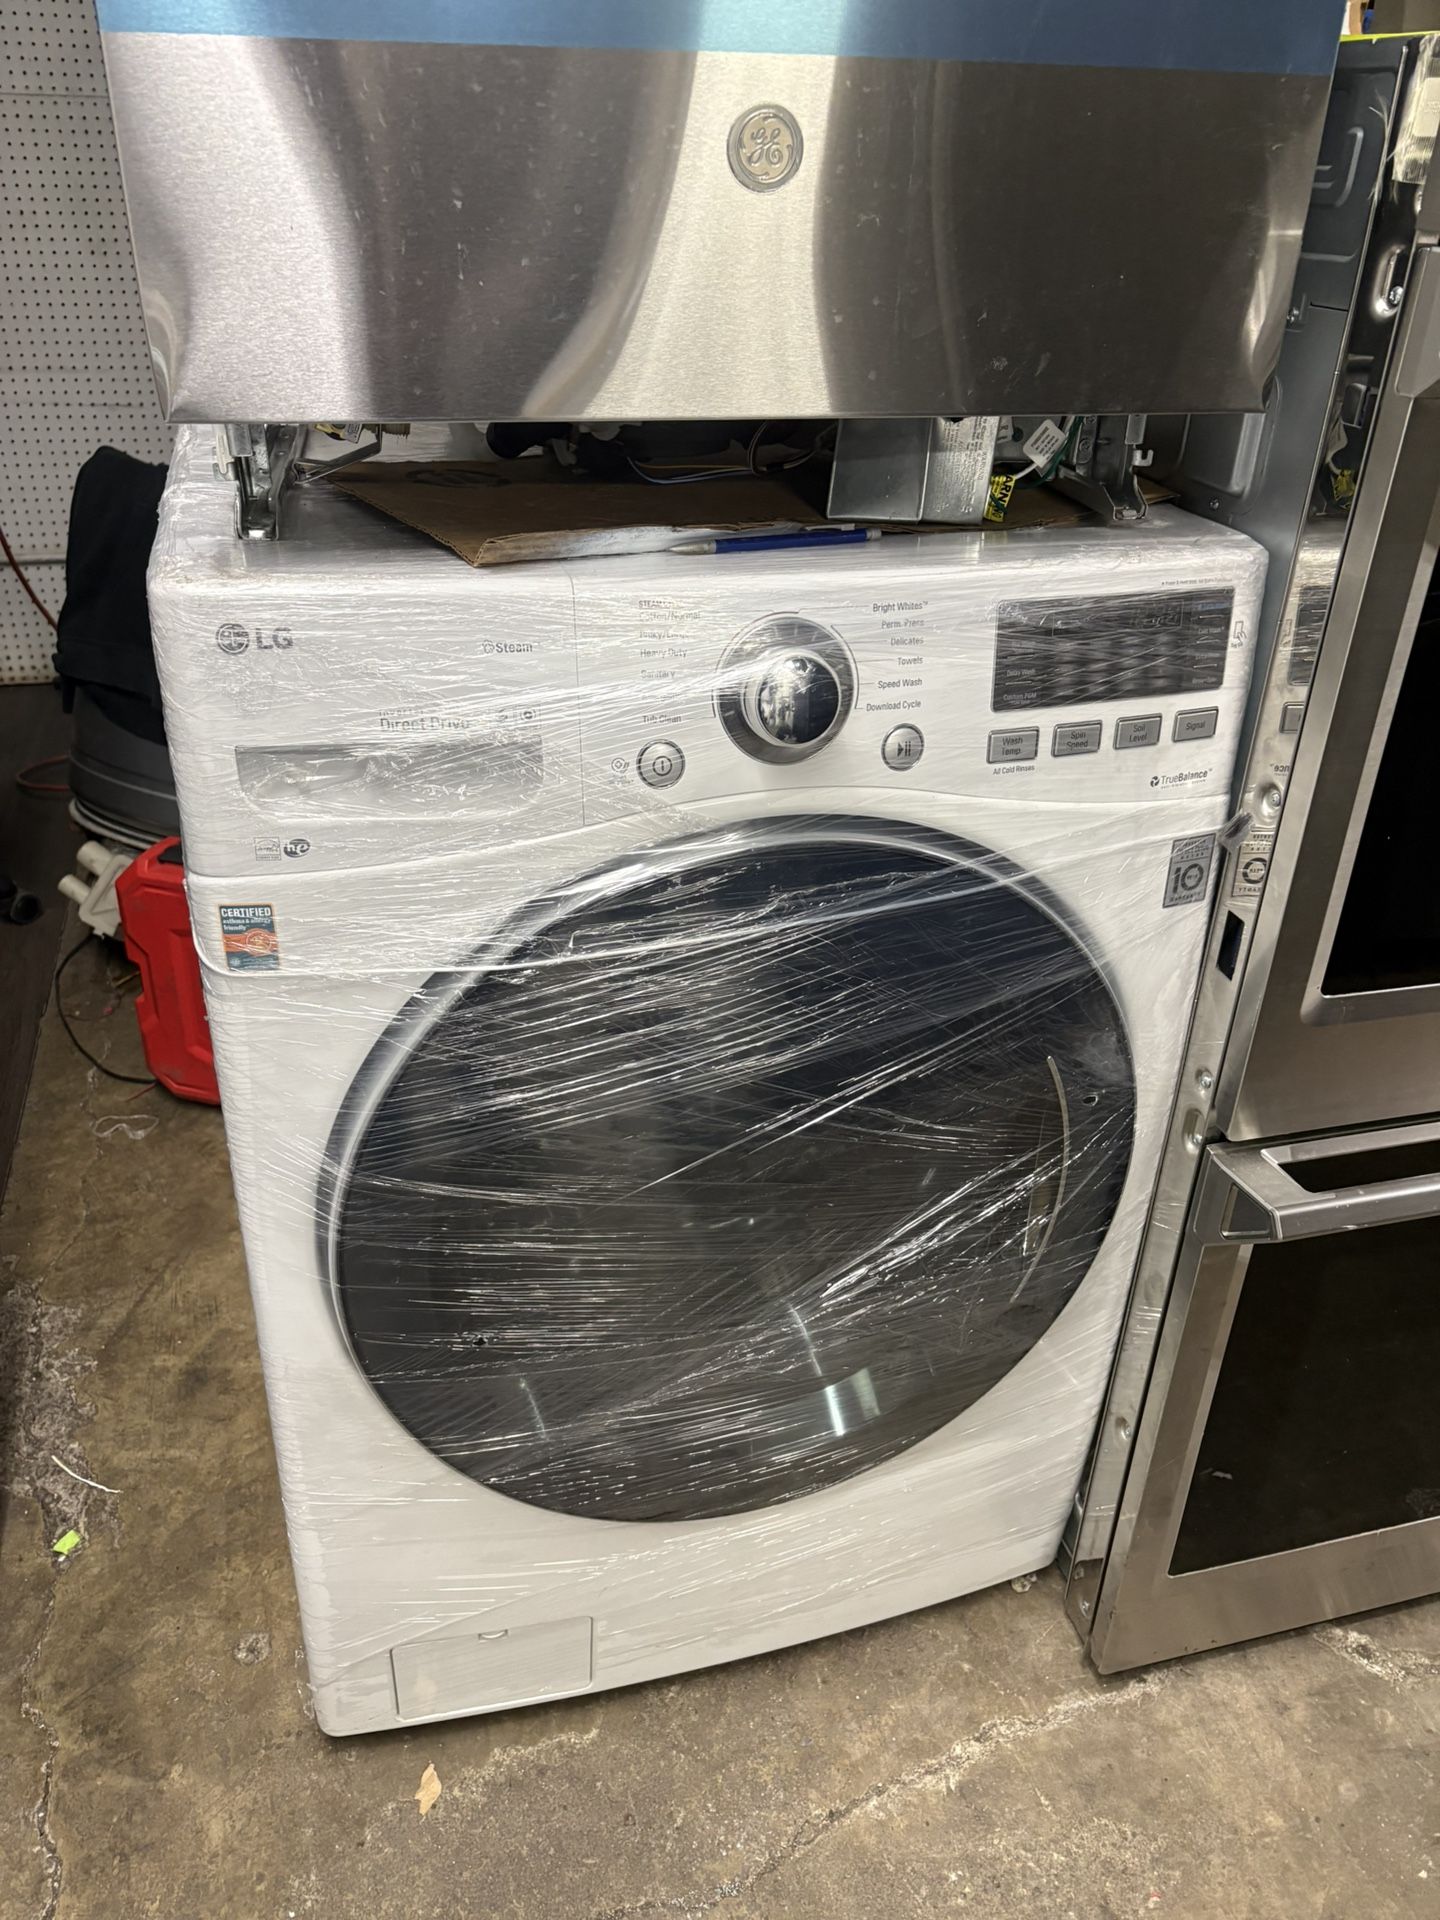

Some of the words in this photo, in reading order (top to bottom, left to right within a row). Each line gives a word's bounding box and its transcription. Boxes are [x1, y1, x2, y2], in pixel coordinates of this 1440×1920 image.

[873, 603, 896, 613] Bright
[255, 627, 293, 650] LG
[890, 637, 924, 646] Delicates
[496, 642, 533, 653] Steam
[898, 656, 923, 665] Towels
[878, 680, 901, 690] Speed
[902, 679, 922, 687] Wash
[866, 702, 901, 712] Download
[902, 700, 921, 710] Cycle
[1133, 724, 1146, 733] Soil
[1186, 721, 1206, 731] Signal
[1070, 731, 1087, 740] Spin
[1129, 733, 1147, 742] Level
[1002, 737, 1023, 746] Wash
[1066, 740, 1089, 751] Speed
[1002, 765, 1015, 774] Cold
[221, 907, 272, 918] CERTIFIED
